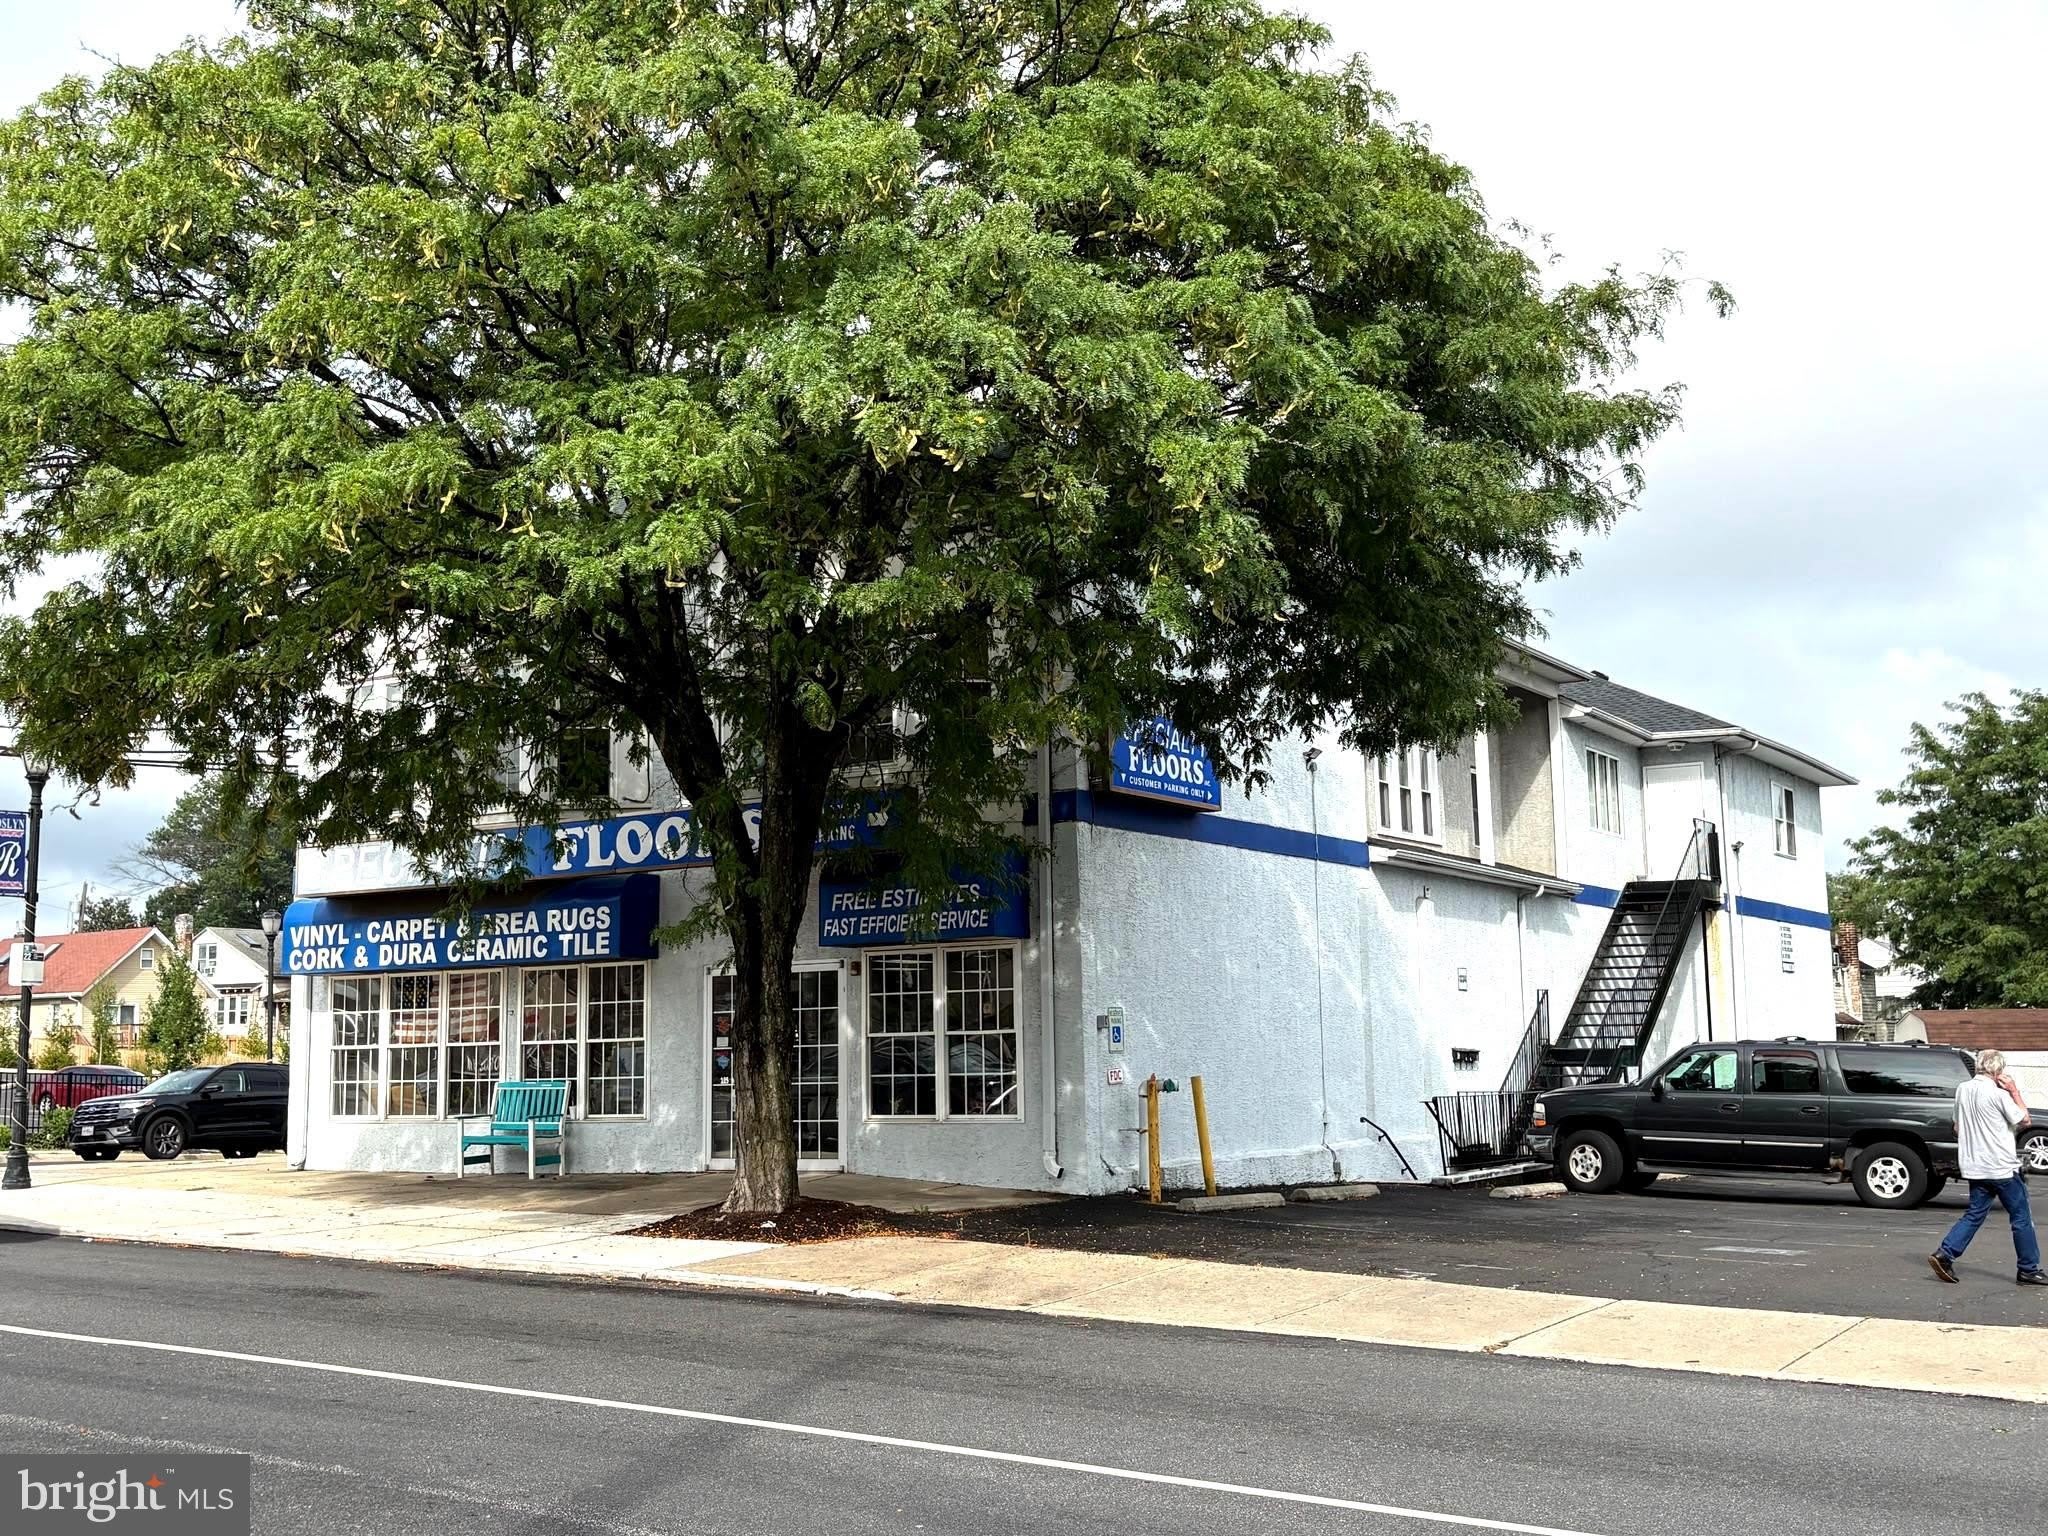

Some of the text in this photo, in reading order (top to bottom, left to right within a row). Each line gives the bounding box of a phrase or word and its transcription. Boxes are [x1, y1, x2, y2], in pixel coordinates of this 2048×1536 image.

[1129, 746, 1204, 785] FLOORS
[1129, 776, 1205, 799] CUSTOMER PARKING ONLY
[0, 818, 24, 829] SLYN
[552, 808, 762, 871] FLOOS
[881, 884, 980, 908] ESTIES
[290, 923, 349, 949] VINYL
[367, 917, 447, 944] CARPET
[479, 911, 539, 936] AREA
[547, 906, 611, 932] RUGS
[824, 917, 857, 937] FAST
[930, 909, 989, 931] SERVICE
[289, 931, 610, 971] CORK & DURA CERAMIC TILE
[1110, 1070, 1122, 1081] FDC
